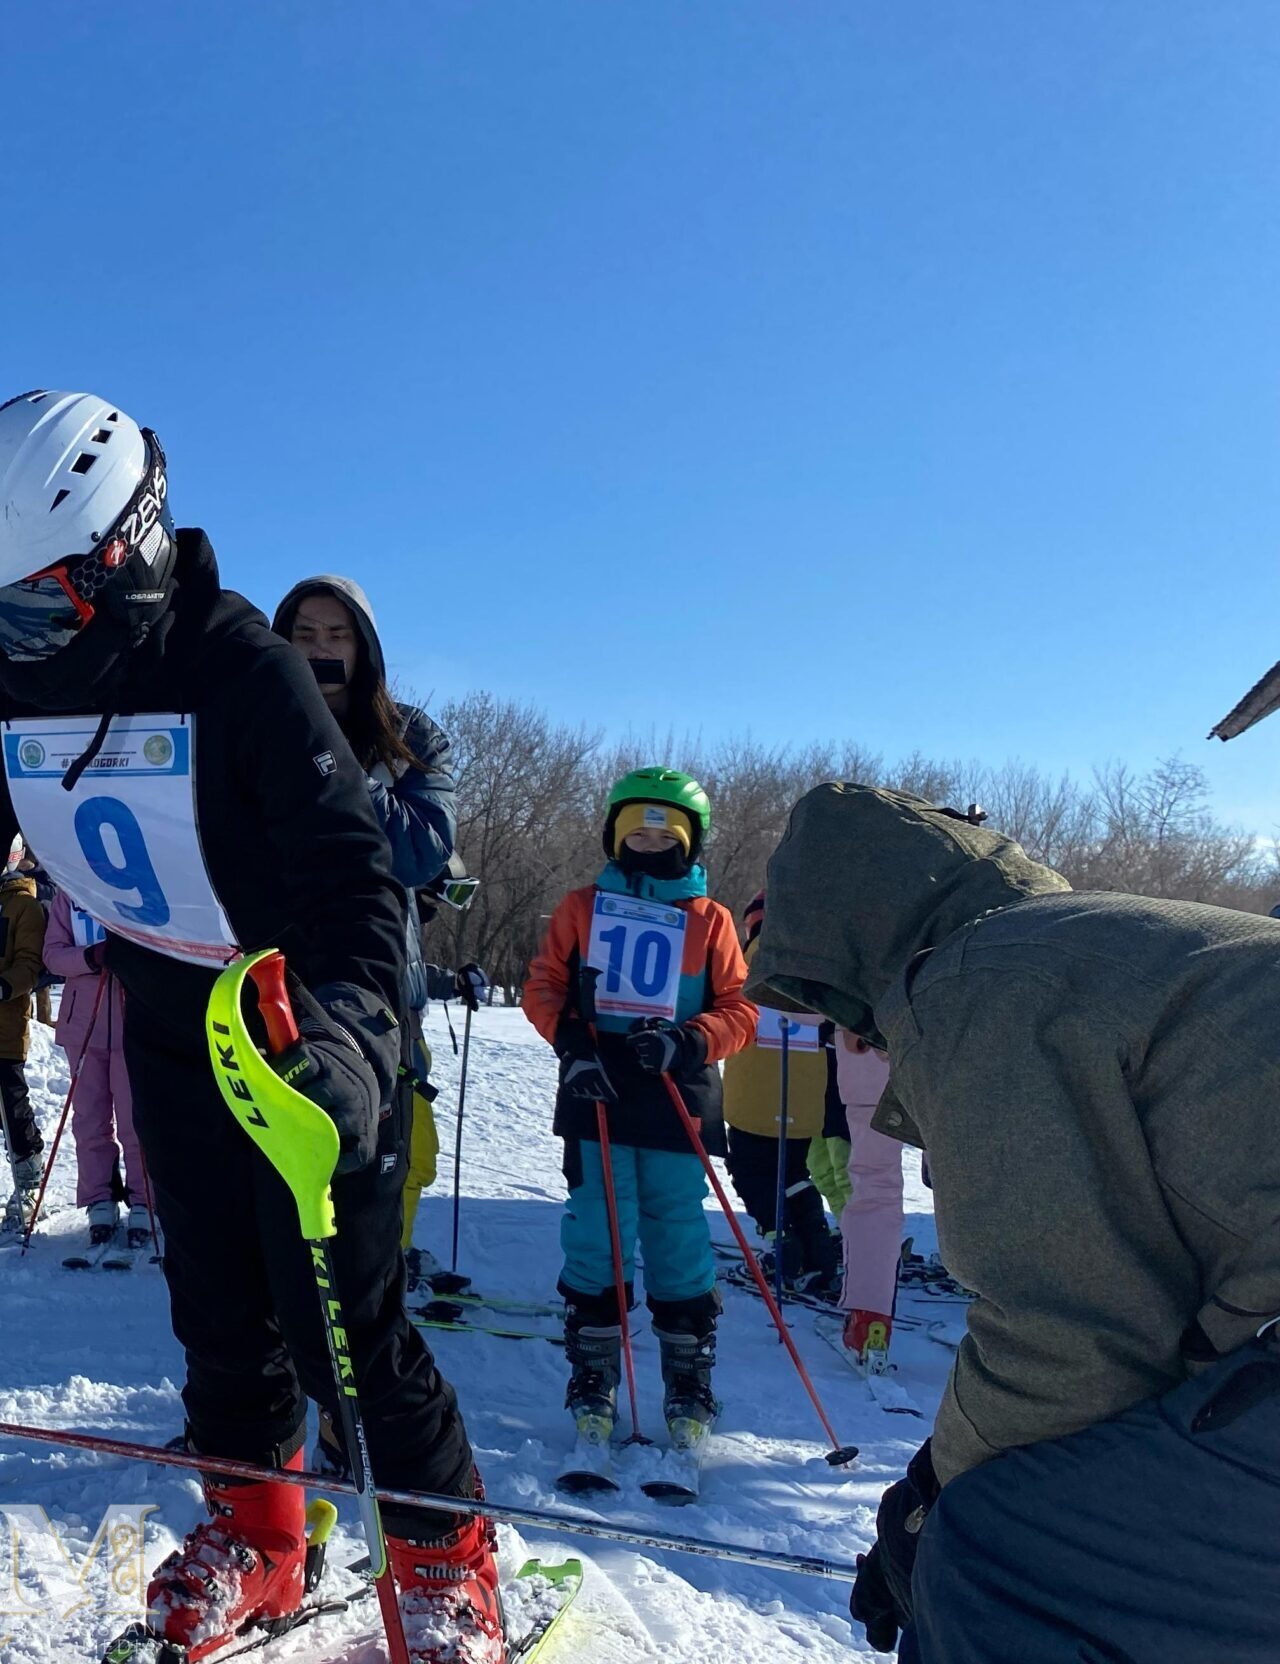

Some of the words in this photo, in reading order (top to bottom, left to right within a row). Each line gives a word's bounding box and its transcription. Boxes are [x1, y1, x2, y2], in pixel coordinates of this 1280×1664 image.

[74, 796, 170, 927] 9
[599, 925, 672, 997] 10
[213, 1020, 270, 1128] LEKI
[327, 1299, 358, 1398] LEKI
